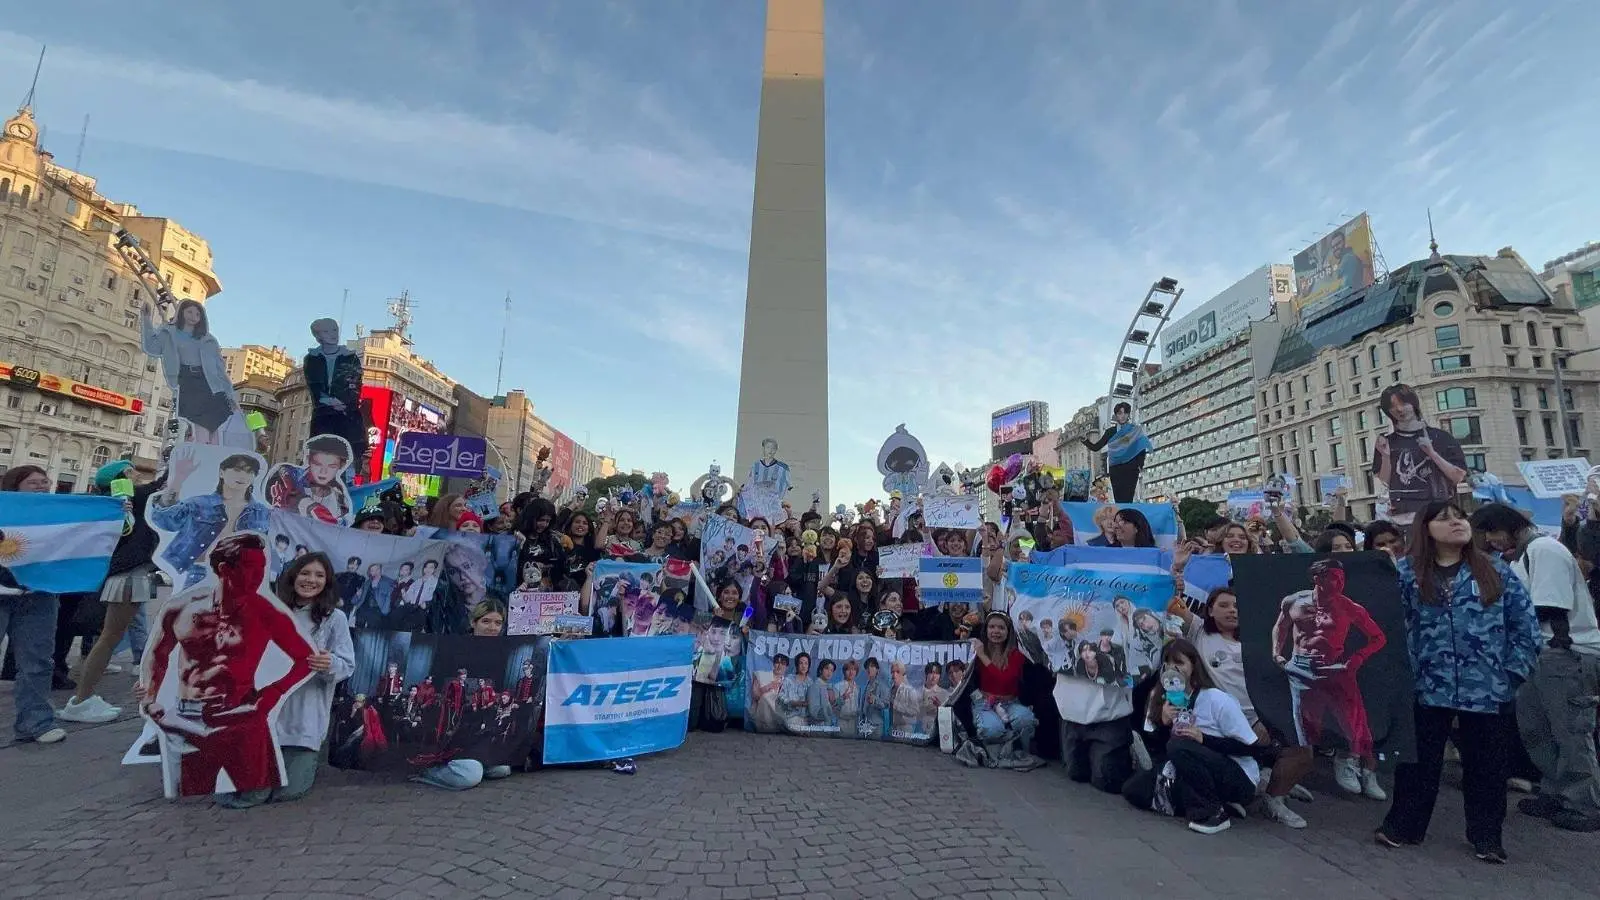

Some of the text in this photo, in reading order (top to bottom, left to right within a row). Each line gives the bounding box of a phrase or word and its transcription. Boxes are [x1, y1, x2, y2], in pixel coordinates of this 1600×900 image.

[1277, 281, 1288, 294] 21
[1165, 329, 1198, 358] SIGLO
[1200, 319, 1214, 339] 21
[398, 437, 484, 474] Kep1er
[1109, 576, 1149, 593] loves
[522, 593, 569, 604] QUEREMOS
[754, 636, 814, 659] STRAY
[818, 639, 865, 661] KIDS
[561, 676, 687, 707] ATEEZ
